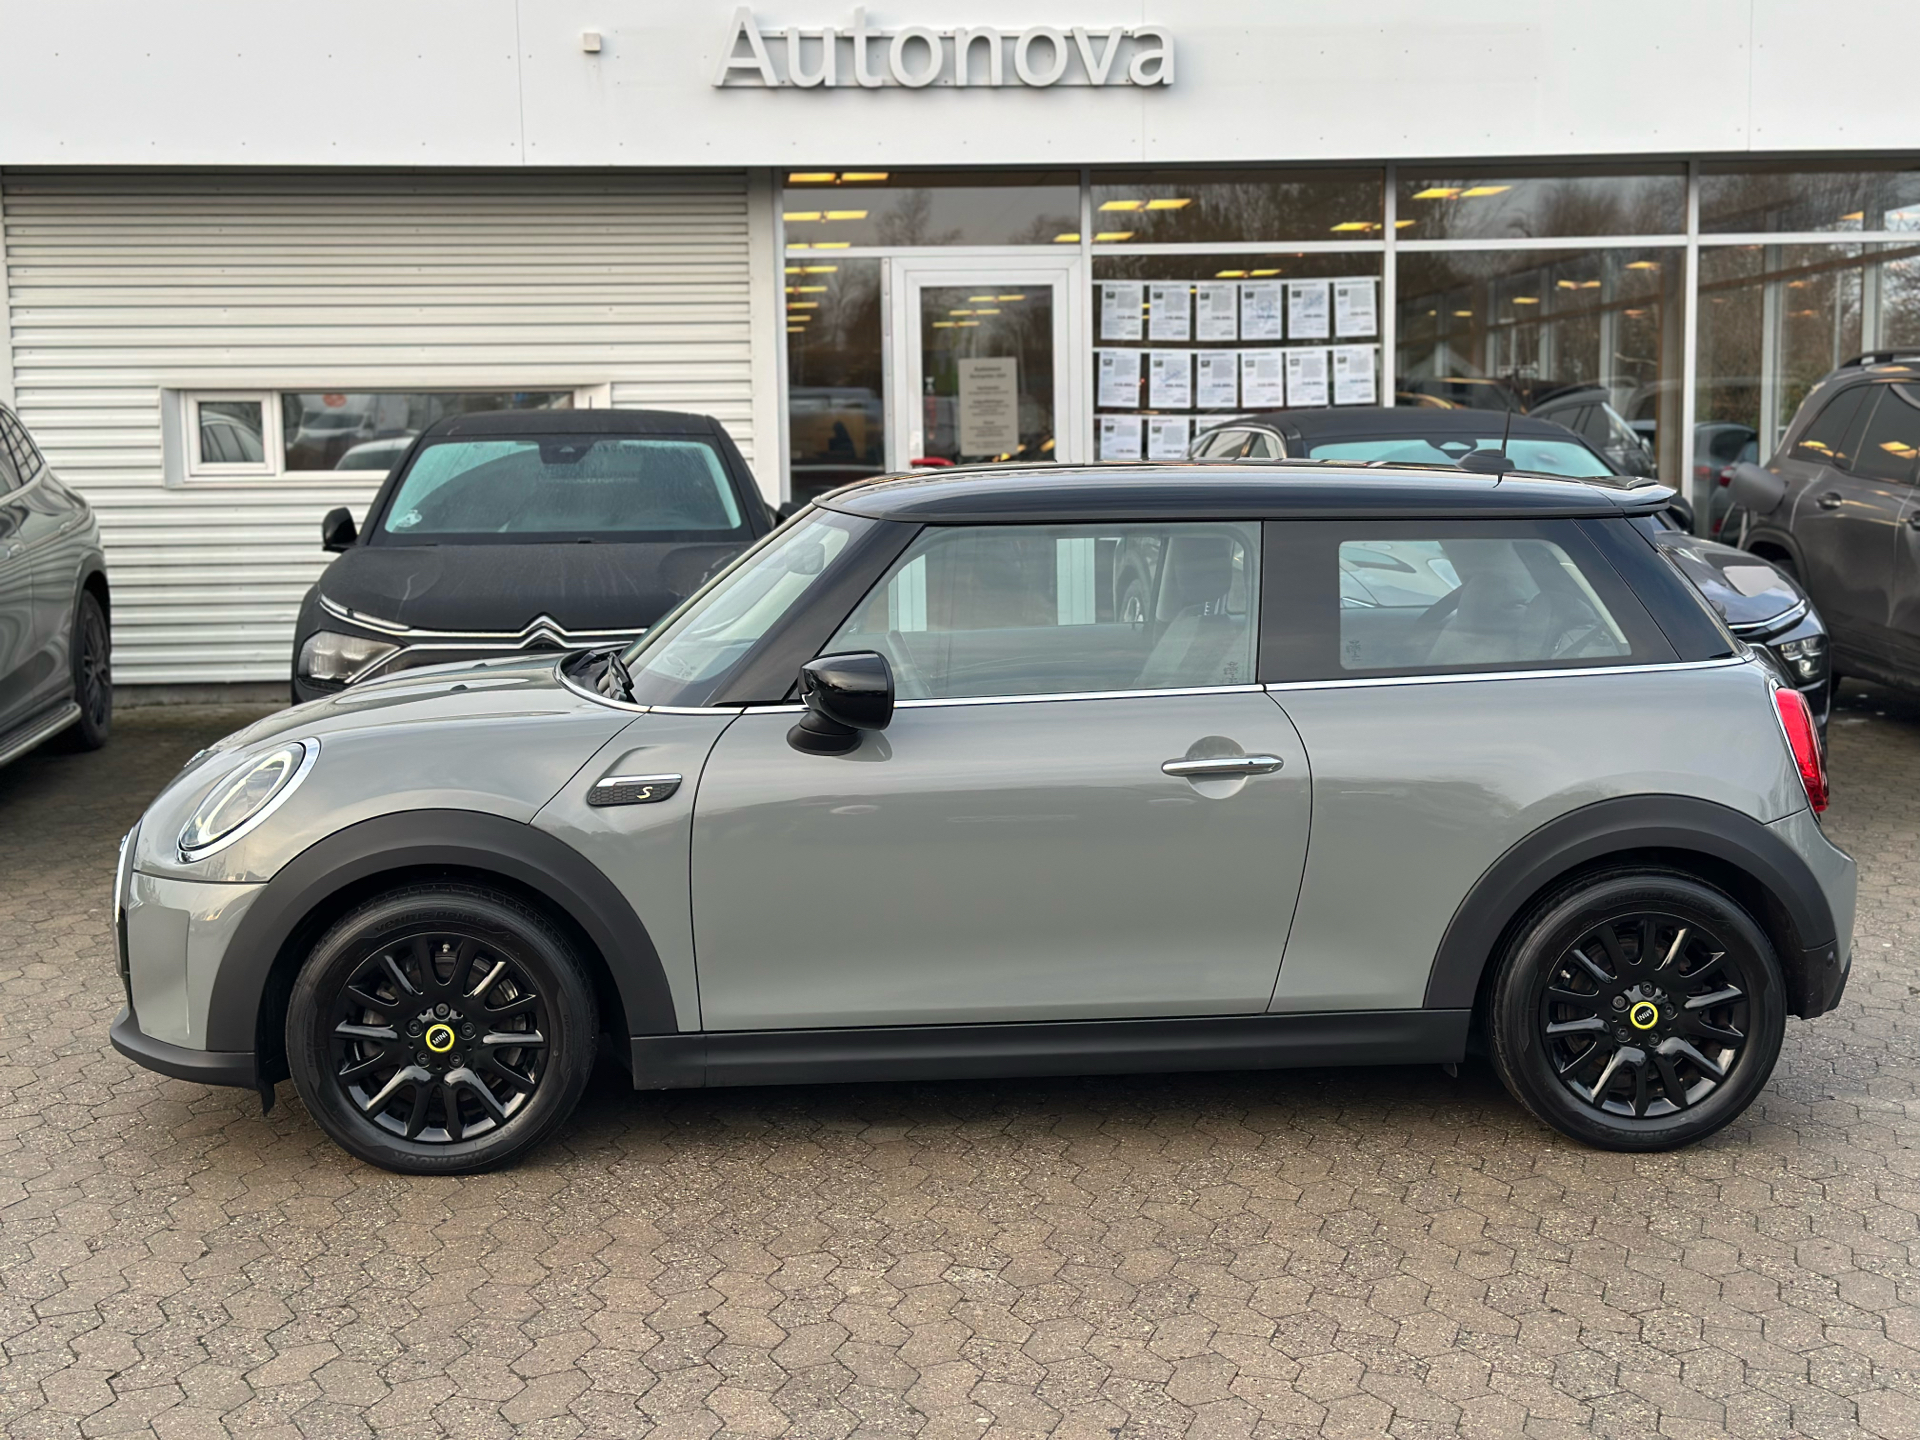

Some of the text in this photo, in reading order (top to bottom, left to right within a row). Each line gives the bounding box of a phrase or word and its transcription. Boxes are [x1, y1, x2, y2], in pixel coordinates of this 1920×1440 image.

[712, 5, 1175, 88] Autonova
[636, 786, 653, 799] S
[431, 1031, 448, 1045] MINI
